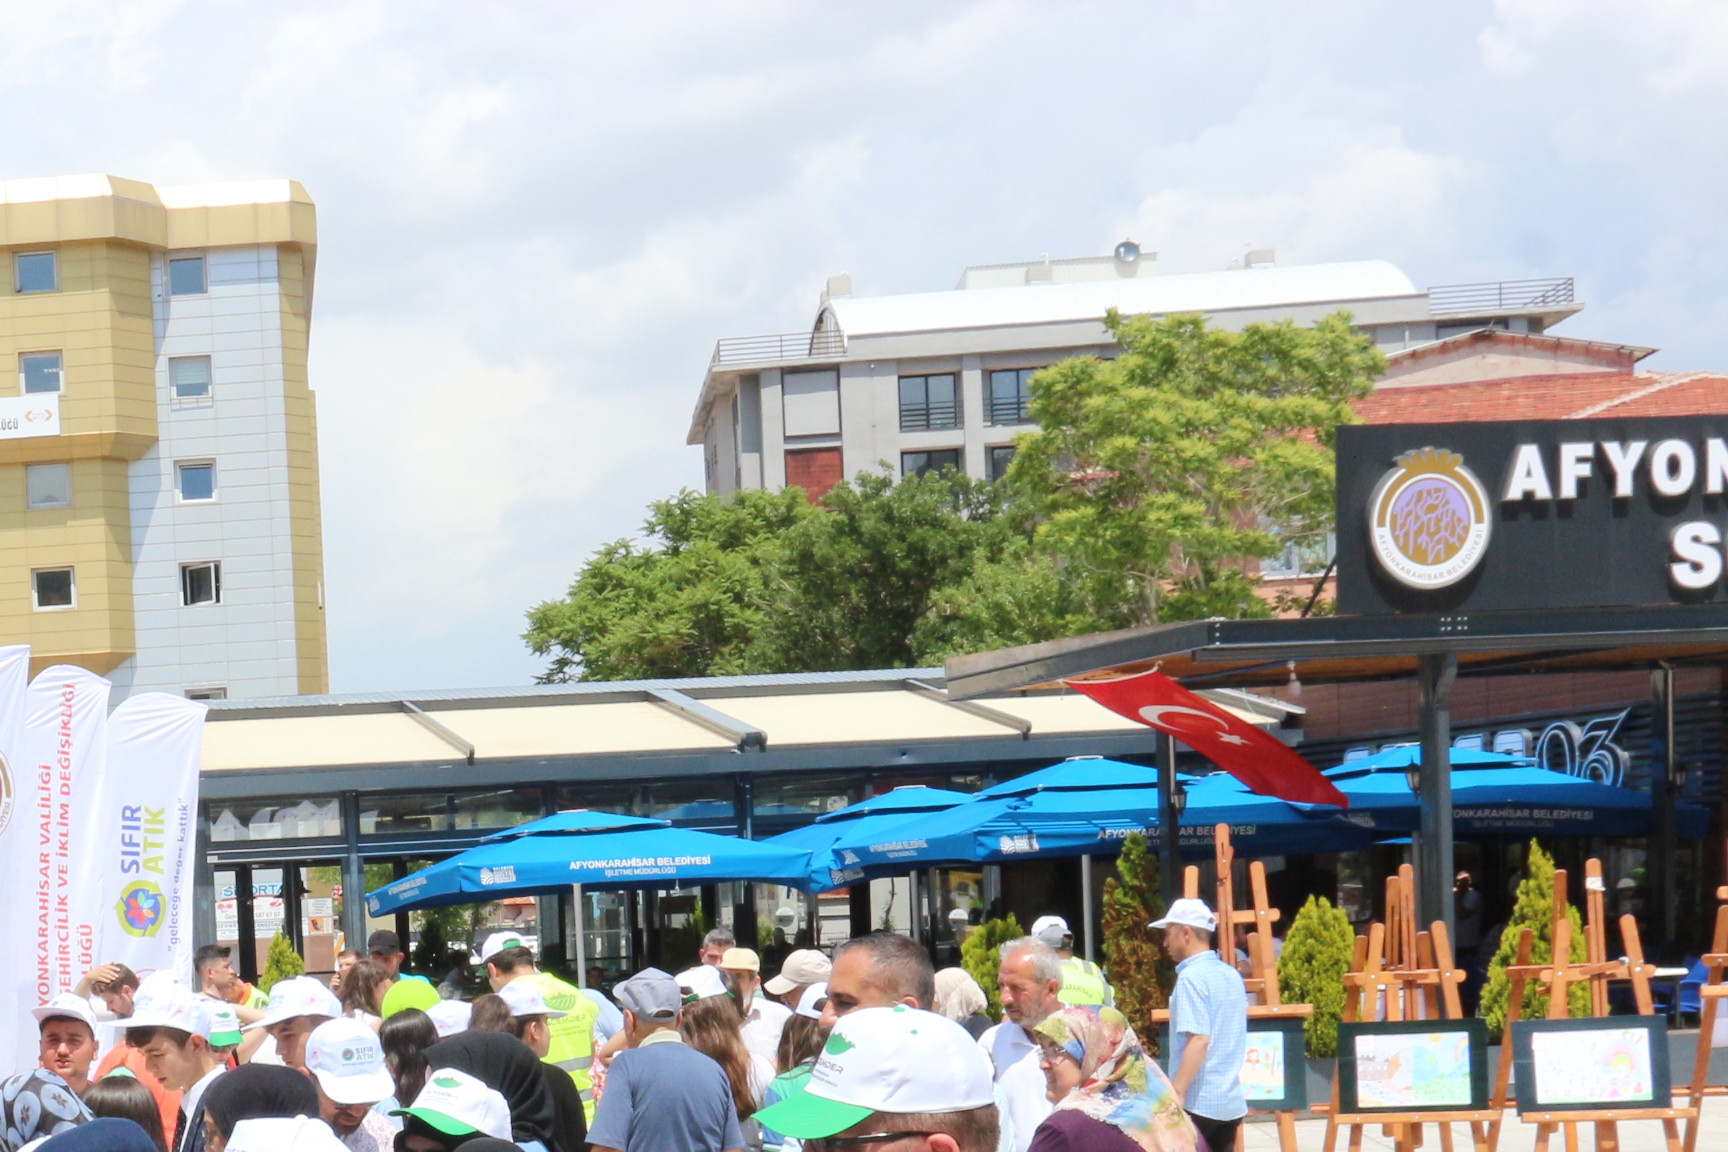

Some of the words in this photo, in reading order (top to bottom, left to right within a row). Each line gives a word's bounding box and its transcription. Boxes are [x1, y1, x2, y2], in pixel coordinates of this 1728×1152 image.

[1670, 520, 1728, 590] S
[120, 804, 142, 874] SIFIR
[142, 805, 166, 875] ATIK
[569, 857, 656, 871] AFYONKARAHİSAR
[657, 854, 711, 867] BELEDİYESİ
[57, 864, 70, 888] VE
